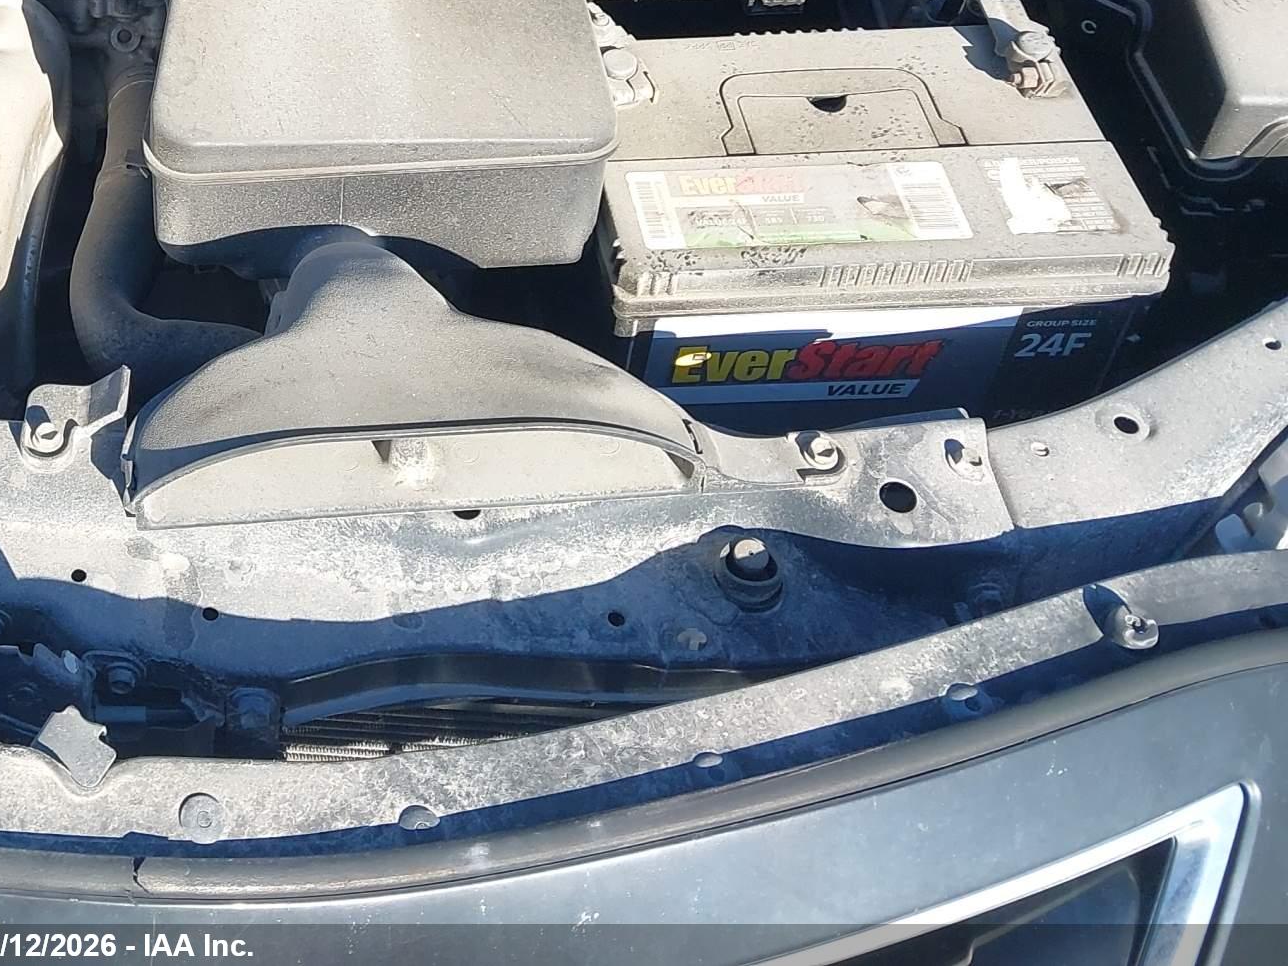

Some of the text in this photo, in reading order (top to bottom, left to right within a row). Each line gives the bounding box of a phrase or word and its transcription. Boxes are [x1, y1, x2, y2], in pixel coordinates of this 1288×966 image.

[761, 194, 800, 203] VALUE
[1014, 332, 1092, 357] 24F
[672, 340, 943, 384] EverStart
[827, 384, 906, 396] VALUE
